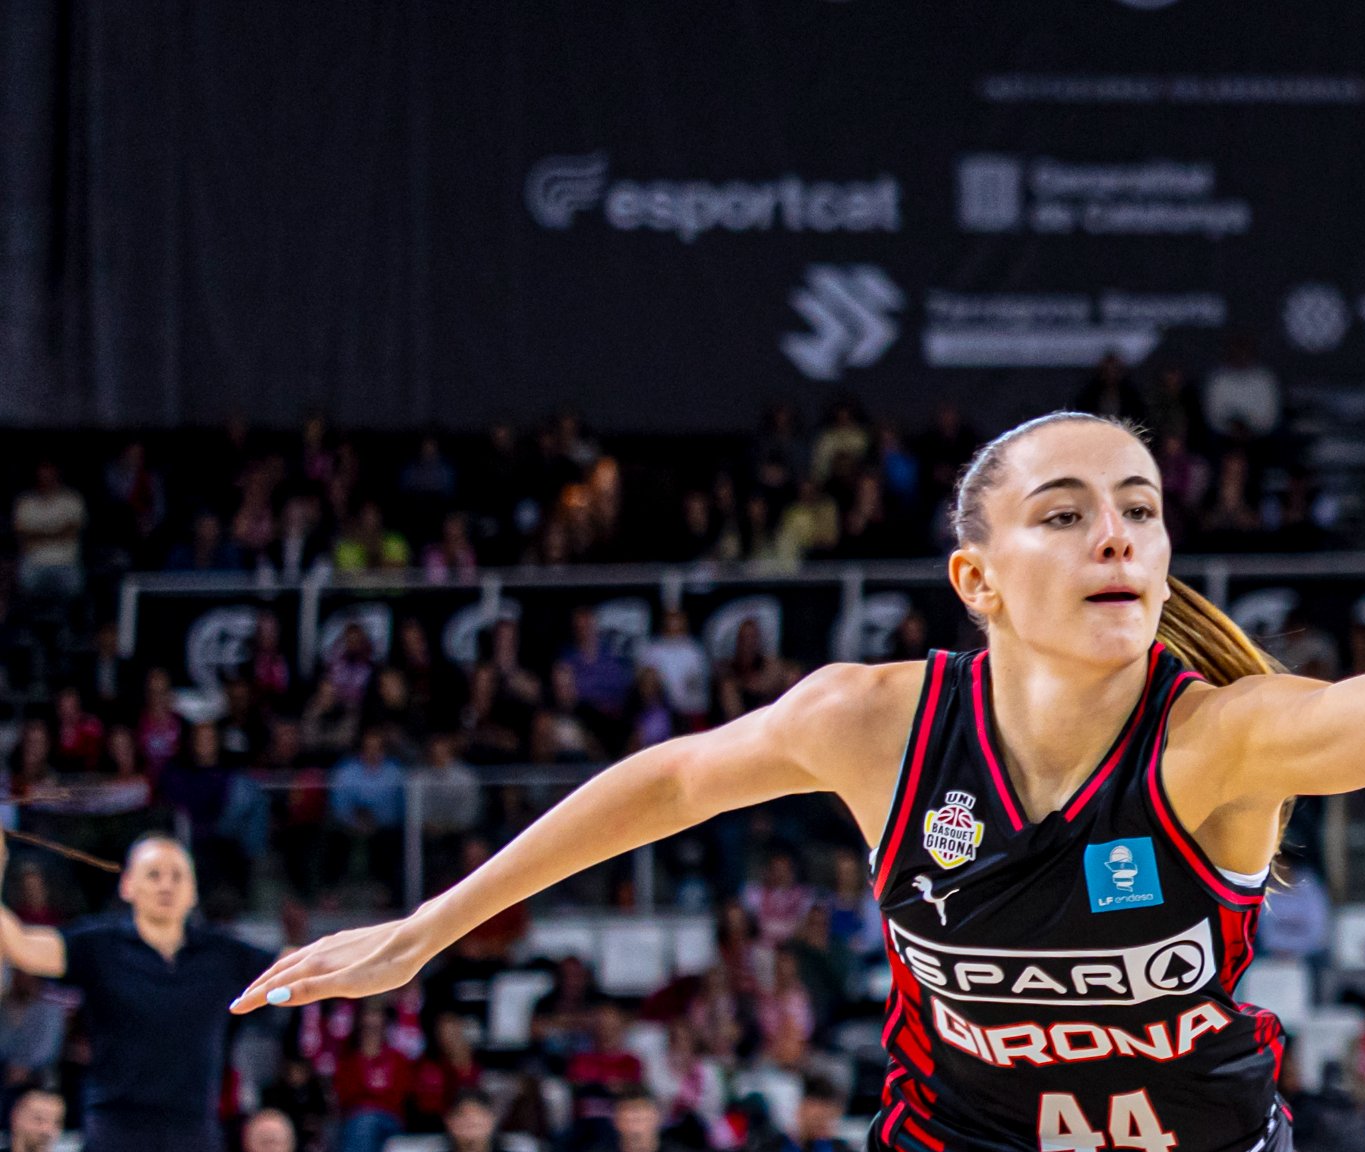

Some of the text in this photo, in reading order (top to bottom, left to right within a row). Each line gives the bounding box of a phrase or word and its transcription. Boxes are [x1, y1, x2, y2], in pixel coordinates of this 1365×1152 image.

[931, 822, 975, 842] BASQUET
[926, 834, 974, 860] GIRONA
[1098, 896, 1113, 907] LF
[905, 946, 1128, 995] SPAR
[930, 997, 1233, 1069] GIRONA
